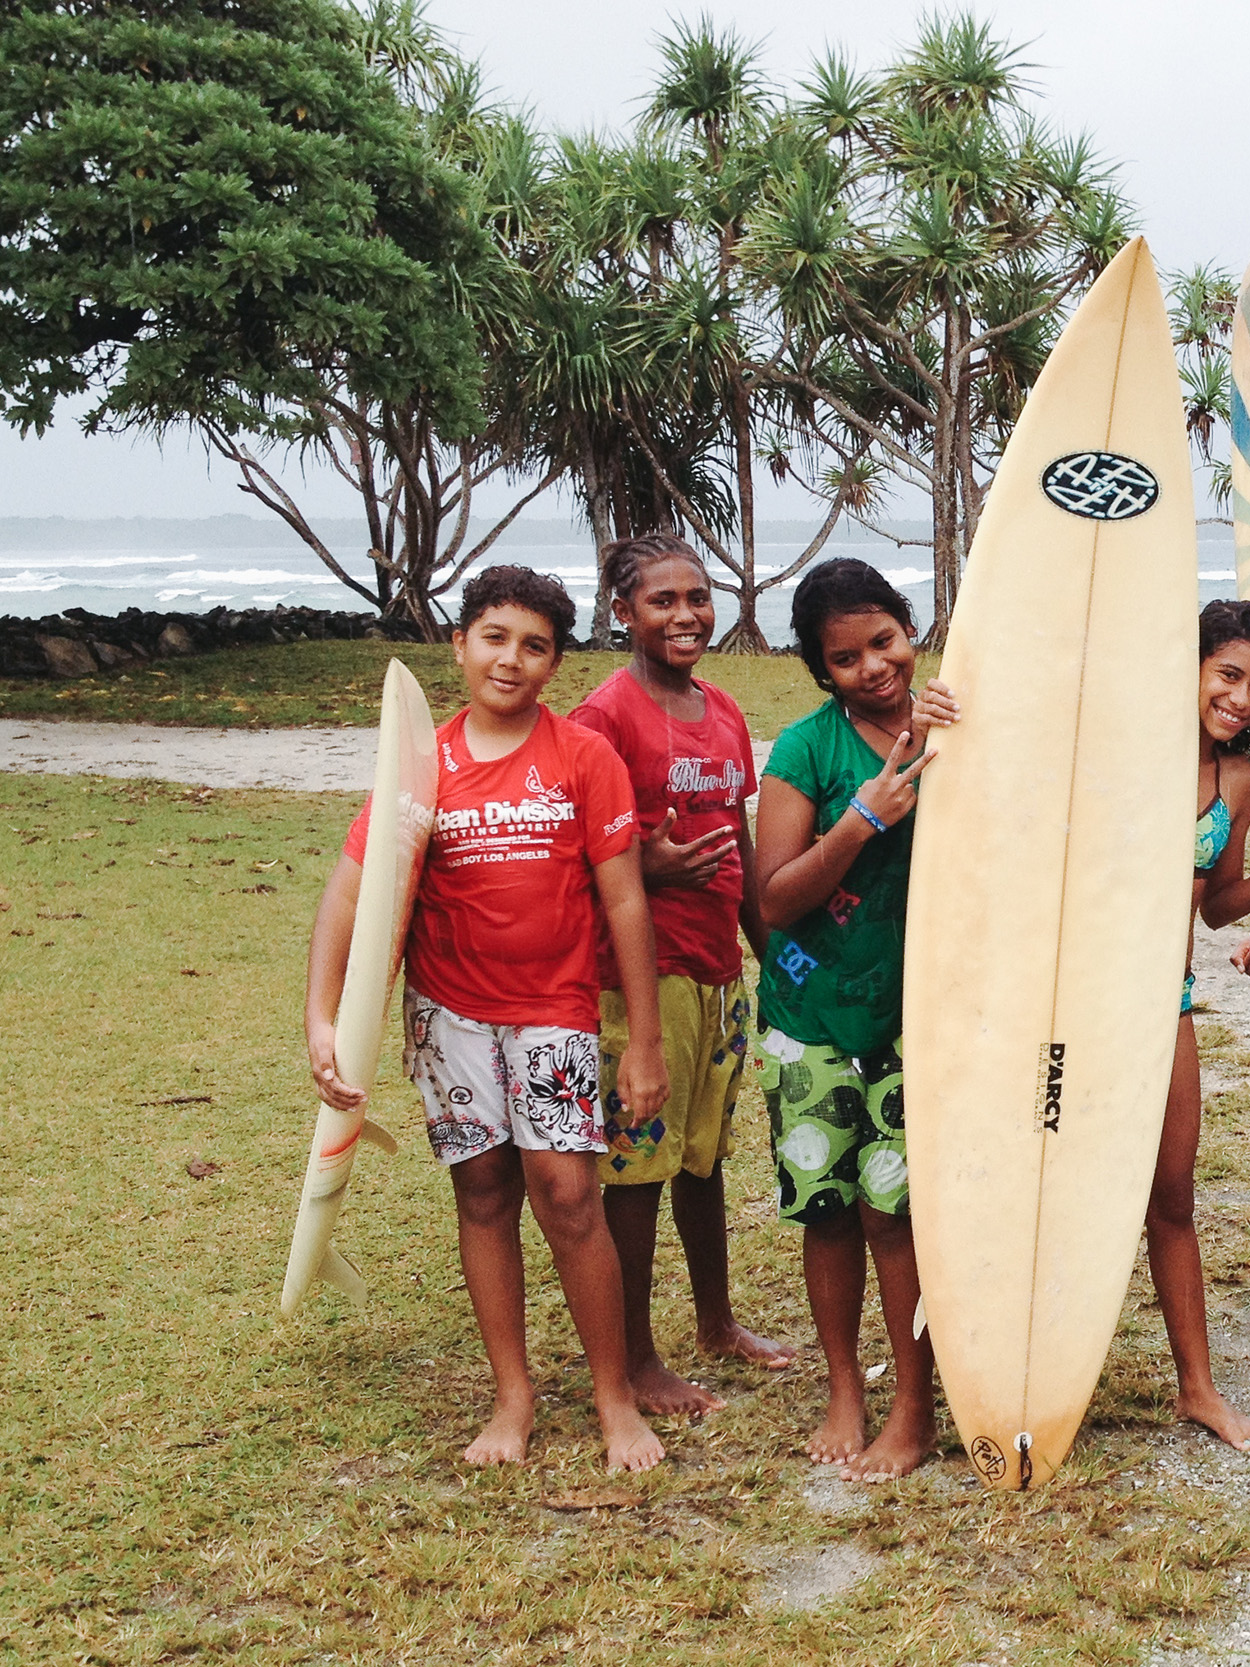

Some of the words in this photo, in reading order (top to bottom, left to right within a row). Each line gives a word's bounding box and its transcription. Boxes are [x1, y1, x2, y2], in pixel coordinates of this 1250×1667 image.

[667, 761, 718, 793] Blue
[484, 799, 575, 826] Division
[507, 822, 561, 834] SPIRIT
[463, 853, 482, 865] BOY
[483, 852, 504, 863] LOS
[505, 850, 550, 862] ANGELES
[1044, 1043, 1065, 1134] D'ARCY
